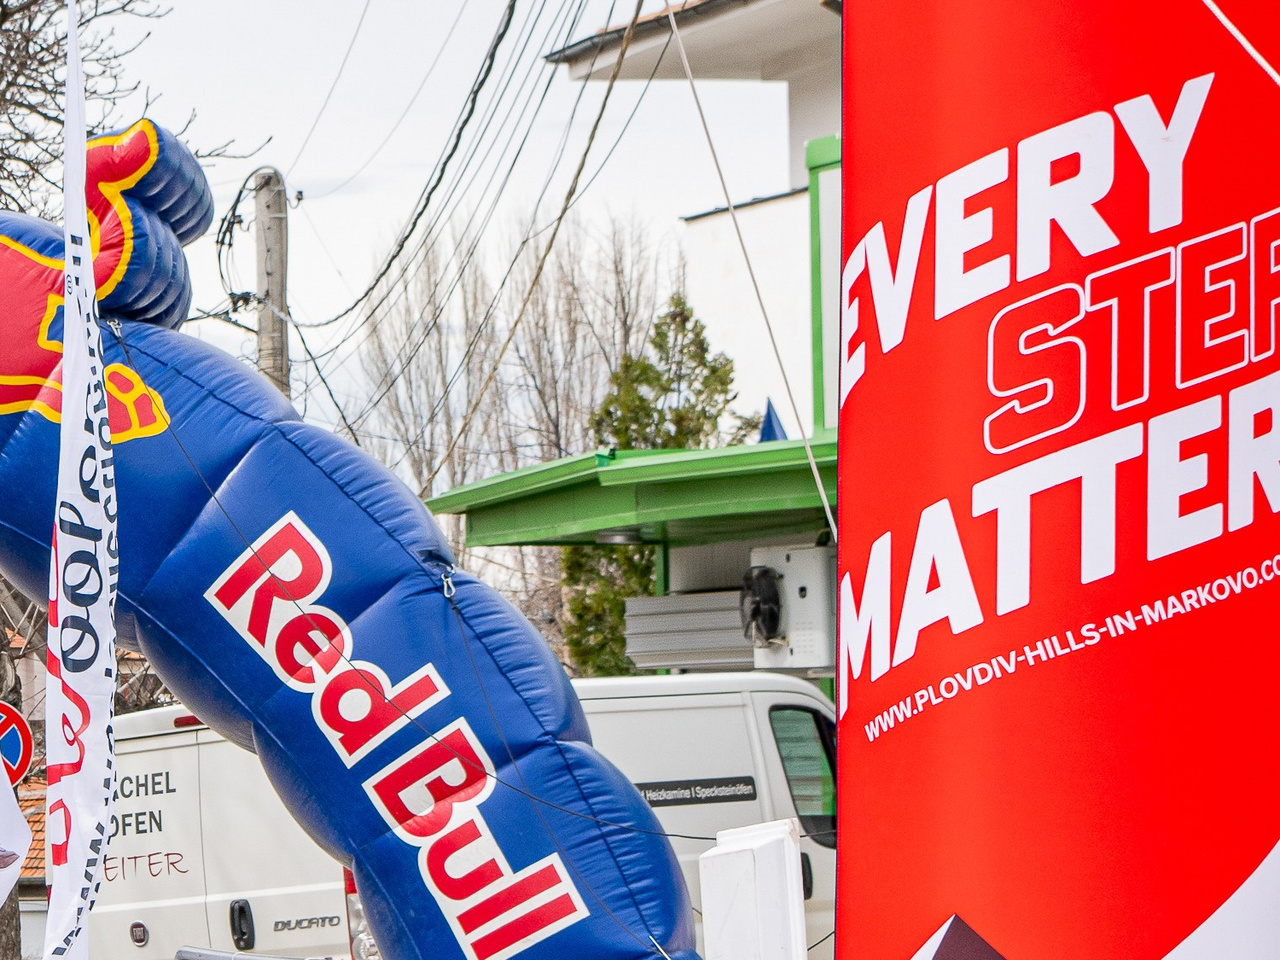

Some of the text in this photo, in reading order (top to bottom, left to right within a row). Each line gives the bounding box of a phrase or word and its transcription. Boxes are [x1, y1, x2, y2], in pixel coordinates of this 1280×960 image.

[840, 72, 1215, 410] EVERY
[214, 522, 440, 757] Red
[839, 371, 1280, 720] MATTER
[273, 915, 341, 932] DUCATO
